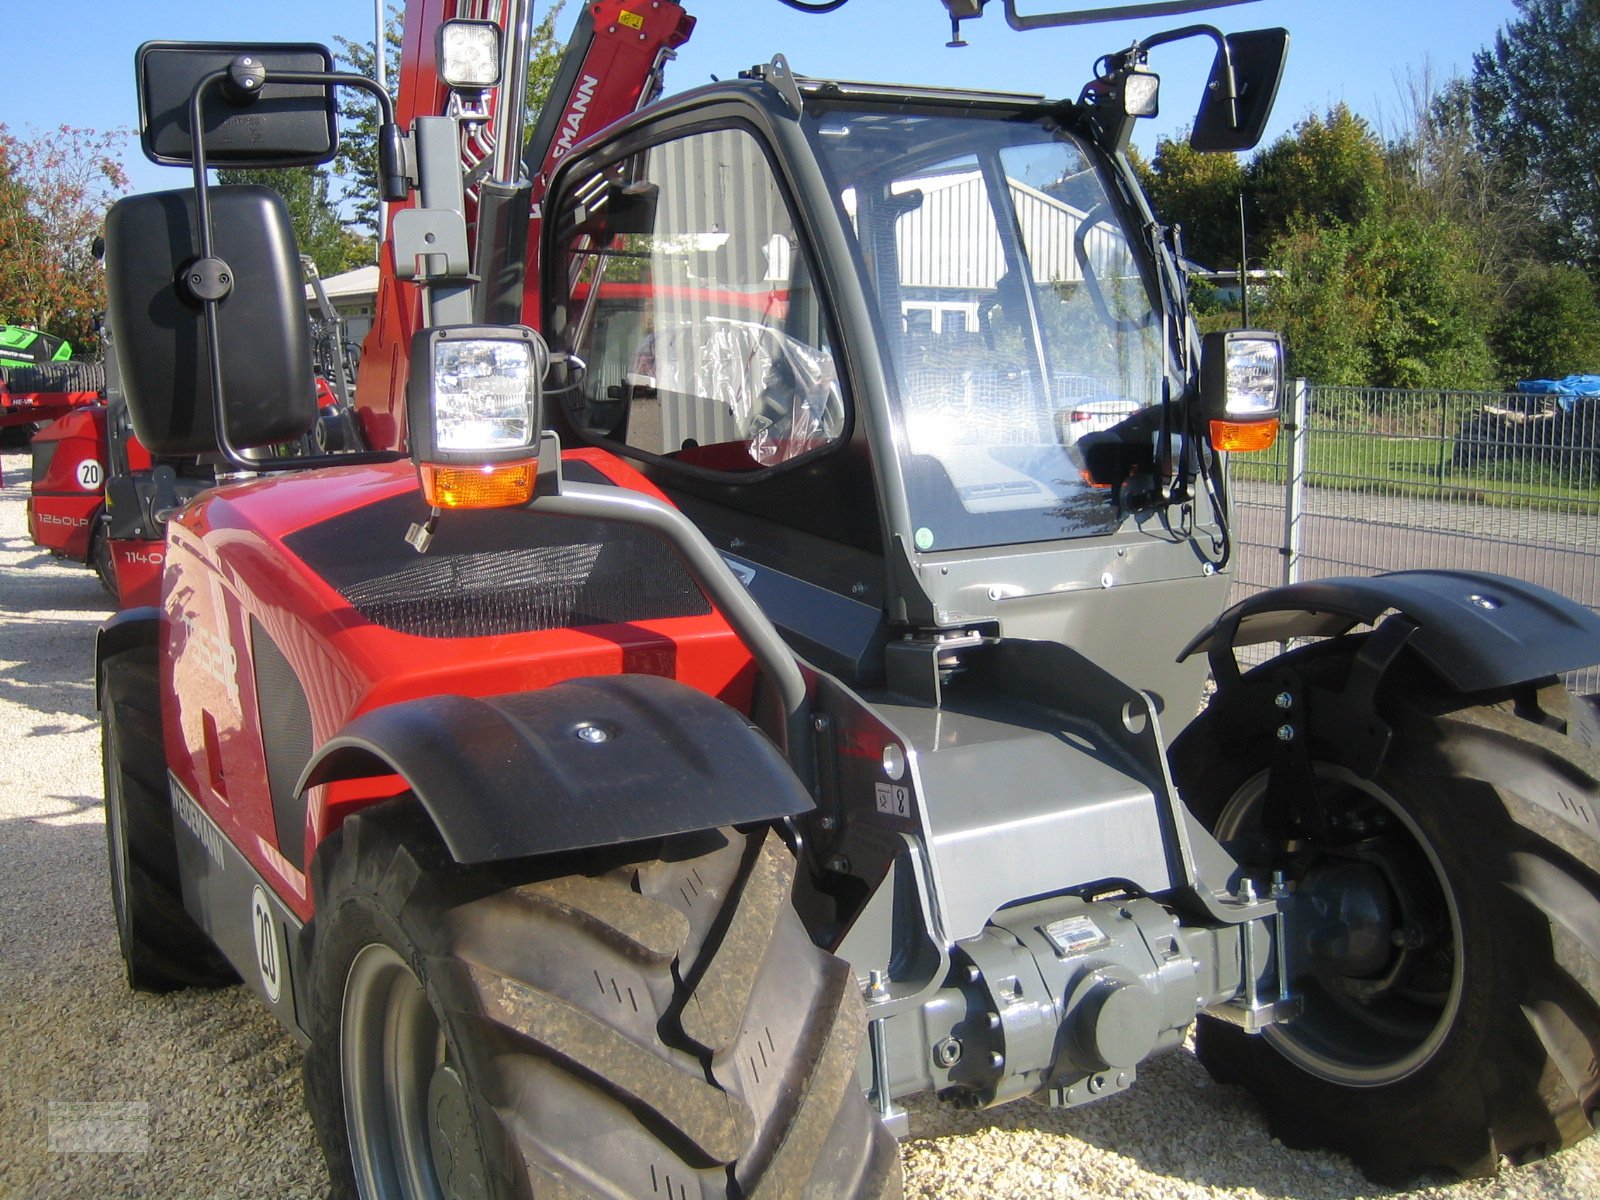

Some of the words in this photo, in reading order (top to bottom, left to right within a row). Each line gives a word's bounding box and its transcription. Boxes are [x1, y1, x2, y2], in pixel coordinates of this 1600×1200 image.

[82, 465, 99, 484] 20
[37, 513, 89, 527] 1260LP
[124, 551, 164, 565] 1140
[169, 779, 225, 871] WEIDEMANN
[256, 903, 276, 985] 20
